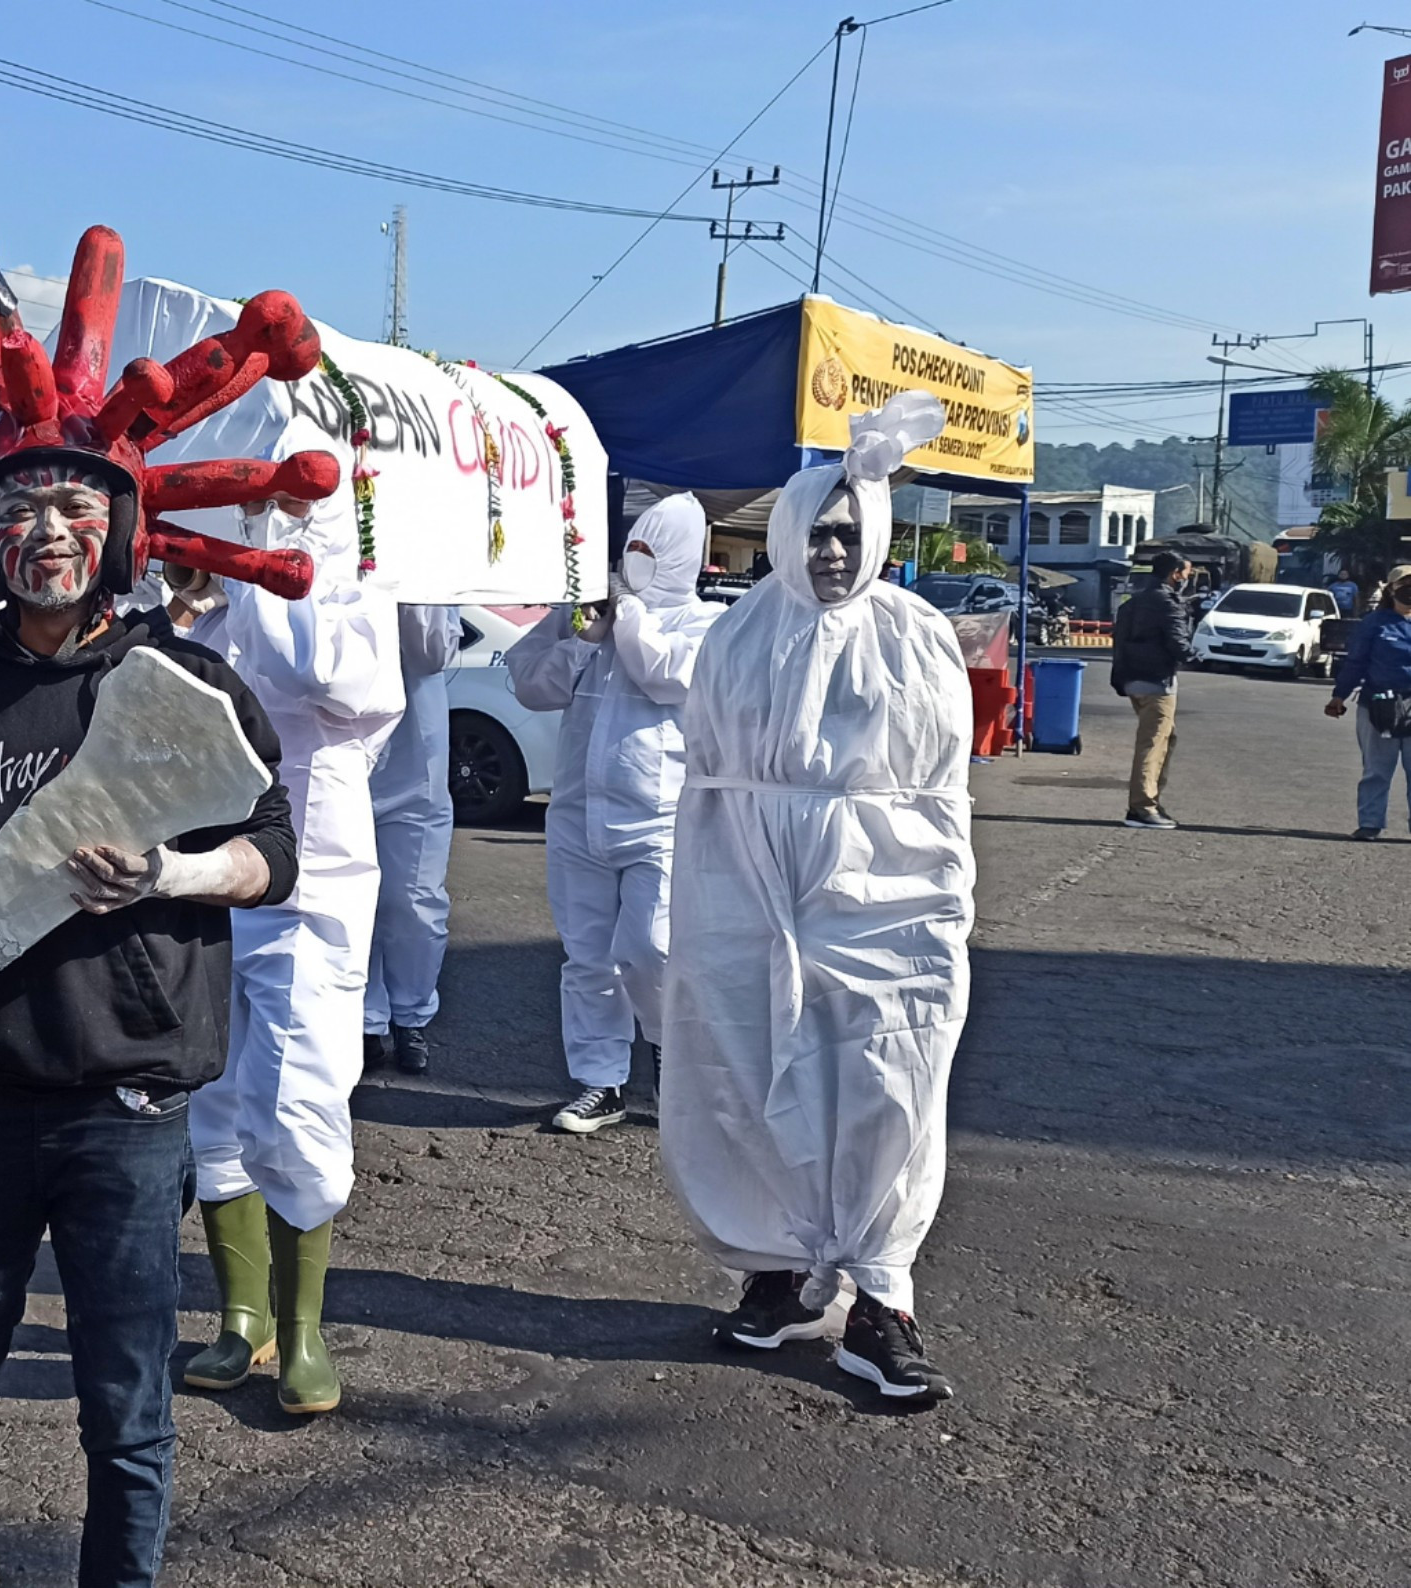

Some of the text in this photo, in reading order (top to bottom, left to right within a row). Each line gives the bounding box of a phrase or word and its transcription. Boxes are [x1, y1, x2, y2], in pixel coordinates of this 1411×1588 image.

[892, 343, 985, 395] POS CHECK POINT
[962, 403, 1011, 438] PROVINSI
